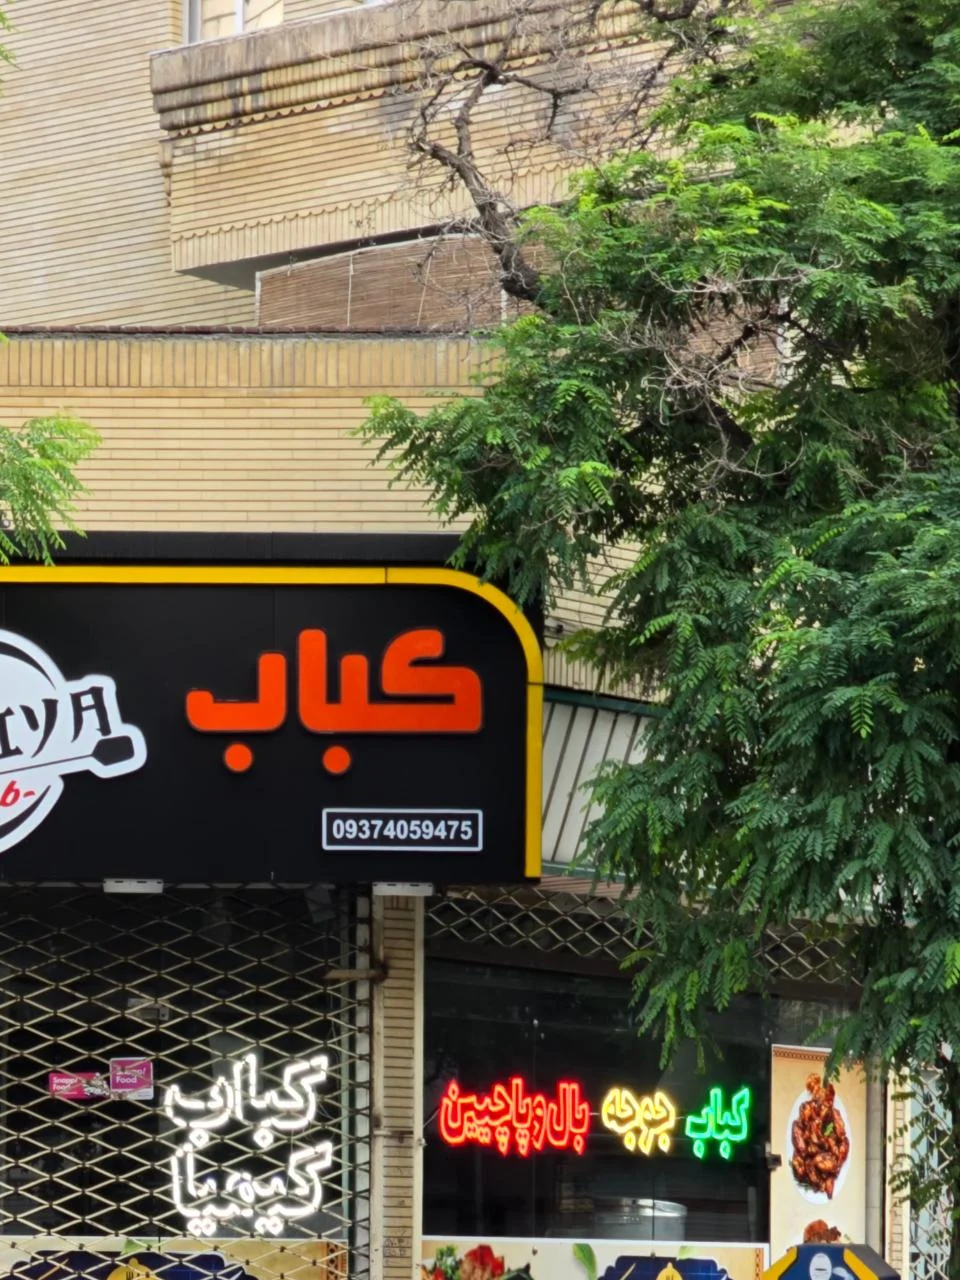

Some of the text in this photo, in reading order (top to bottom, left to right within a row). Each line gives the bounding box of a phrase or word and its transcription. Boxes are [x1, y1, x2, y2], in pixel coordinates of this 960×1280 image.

[185, 628, 483, 775] کباب
[332, 819, 473, 842] 09374059475
[164, 1053, 328, 1148] کباب
[547, 1082, 590, 1155] بال
[601, 1086, 676, 1156] جوجه
[685, 1086, 750, 1159] کباب
[171, 1142, 332, 1236] کیمیا
